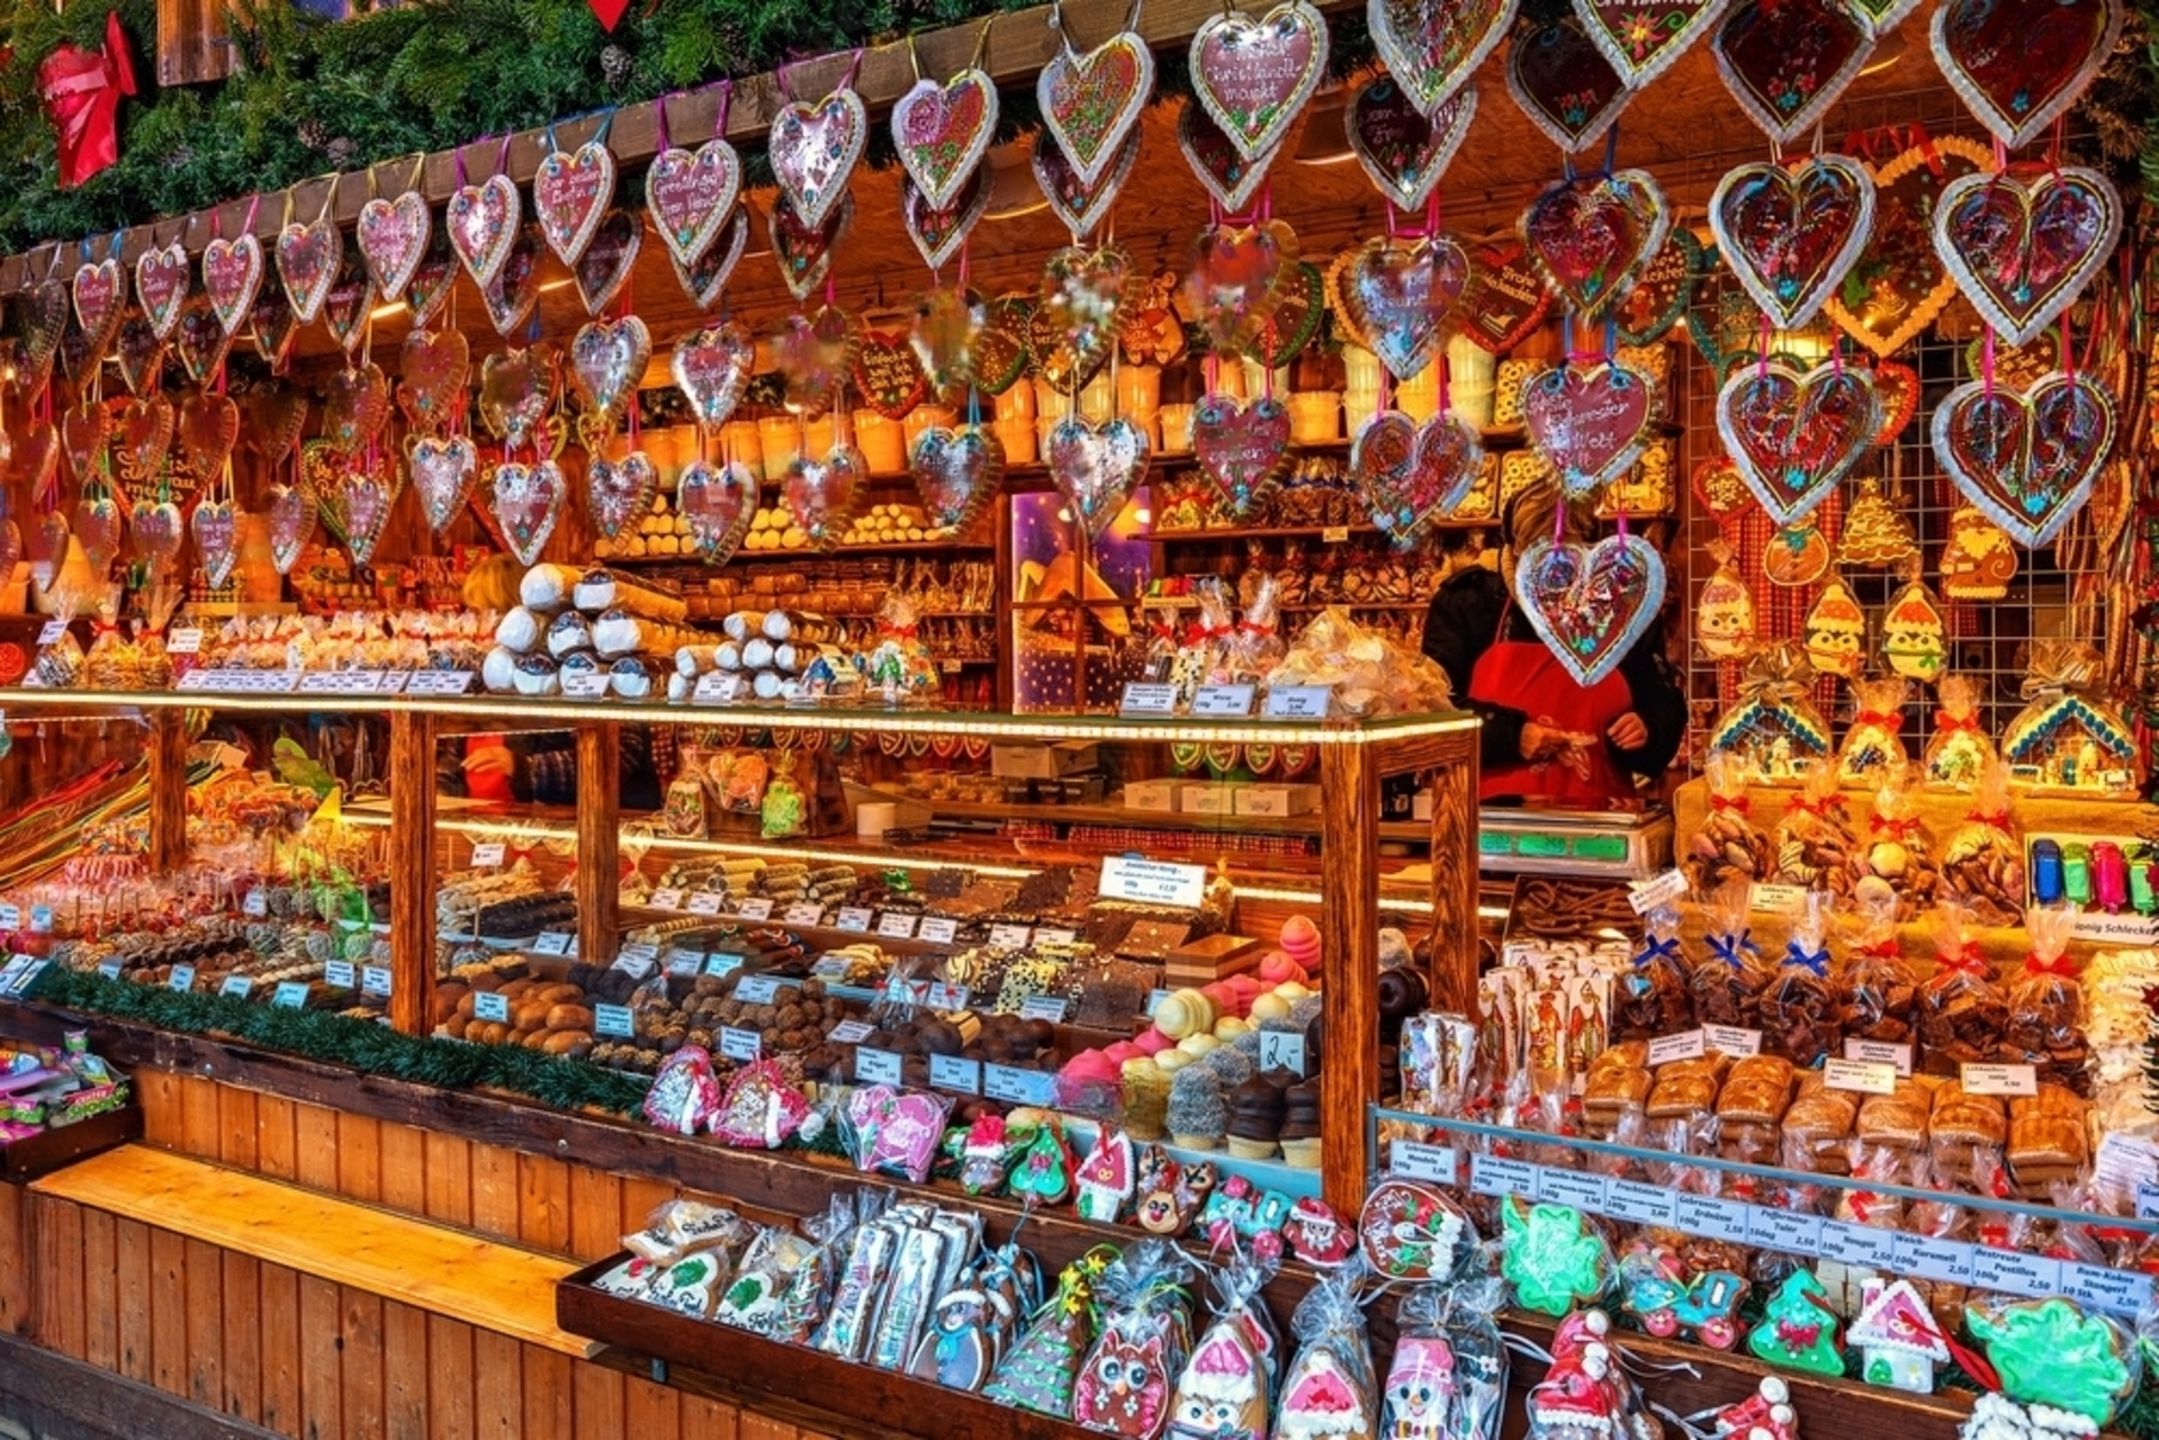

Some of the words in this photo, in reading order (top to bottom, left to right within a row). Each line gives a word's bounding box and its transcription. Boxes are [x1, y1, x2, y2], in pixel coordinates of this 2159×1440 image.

[1679, 1195, 1723, 1210] Gebrannte
[1871, 1250, 1893, 1261] 2,50
[1947, 1264, 1971, 1275] 2,50
[2028, 1278, 2052, 1290] 2,50
[2063, 1286, 2077, 1296] 10
[2116, 1295, 2141, 1307] 2,50
